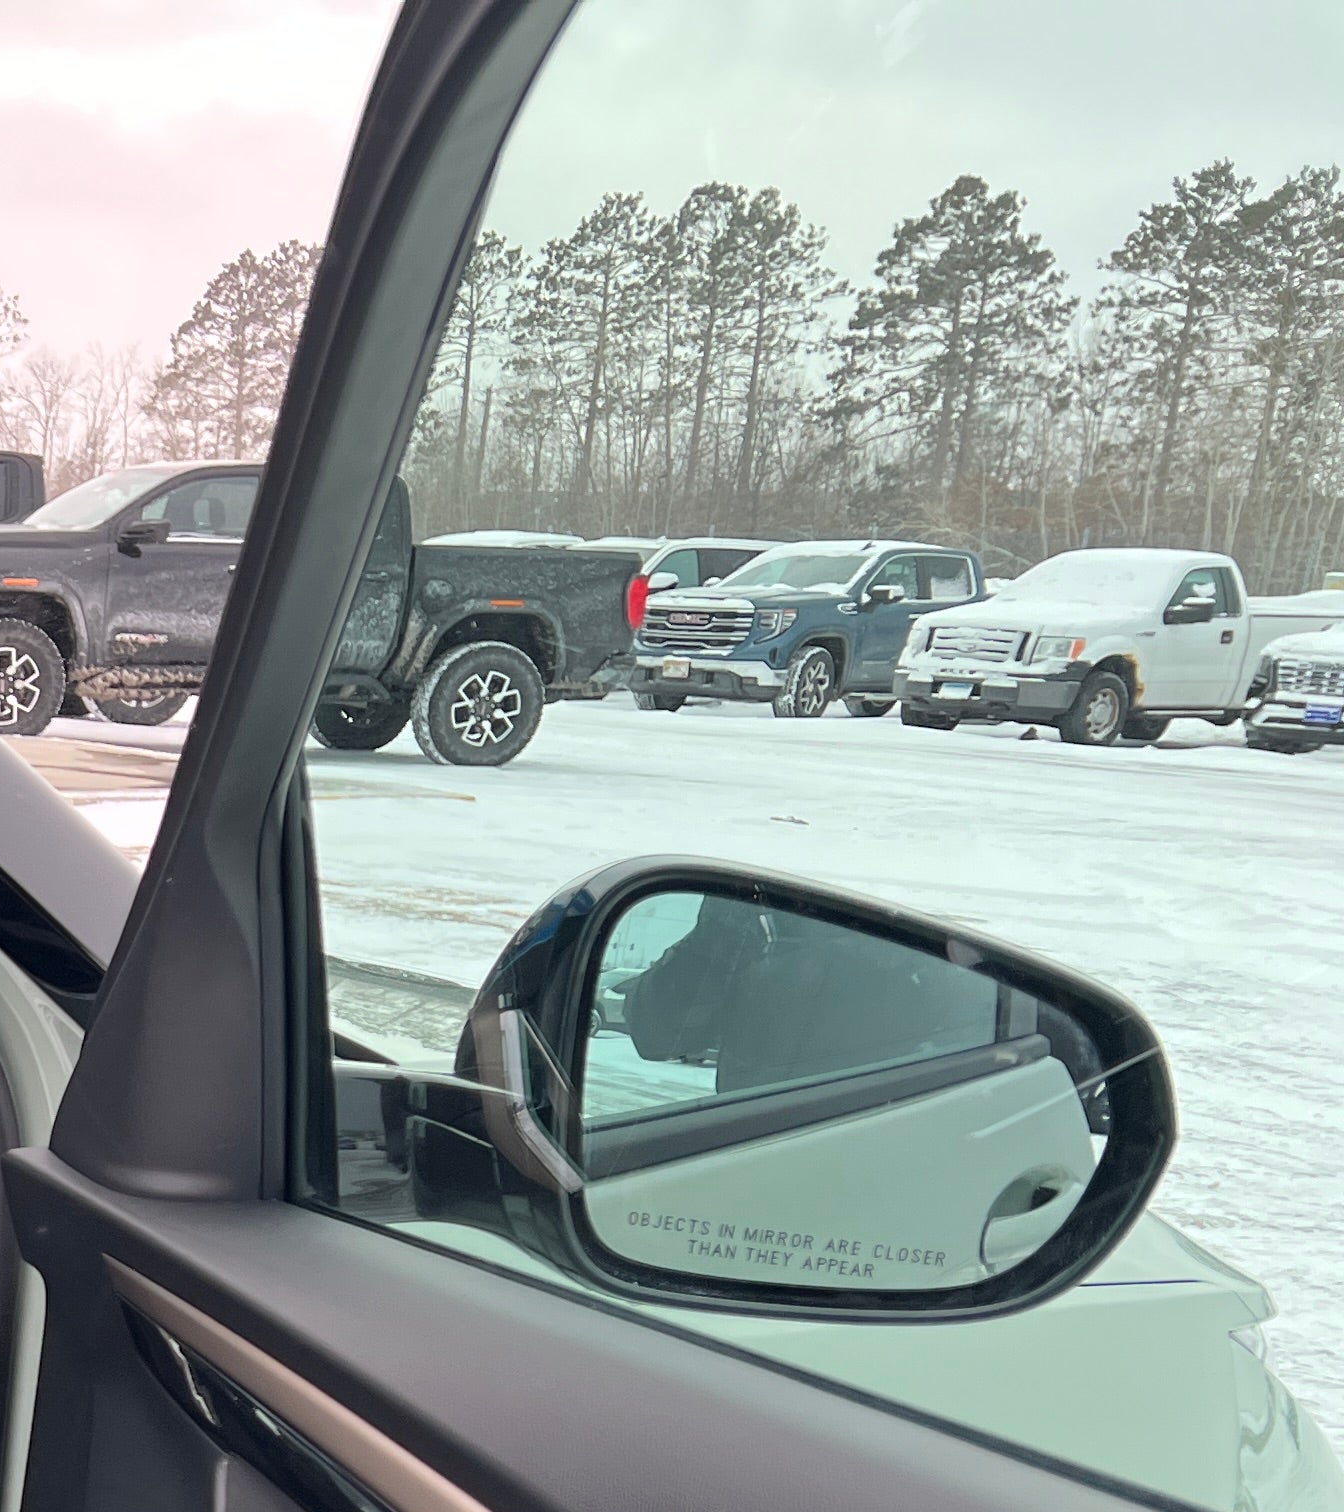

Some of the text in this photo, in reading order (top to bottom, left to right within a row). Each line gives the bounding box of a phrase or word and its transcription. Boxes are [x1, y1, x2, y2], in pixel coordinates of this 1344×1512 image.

[628, 1211, 946, 1267] OBJECTS IN MIRROR ARE CLOSER
[688, 1239, 875, 1278] THAN THEY APPEAR
